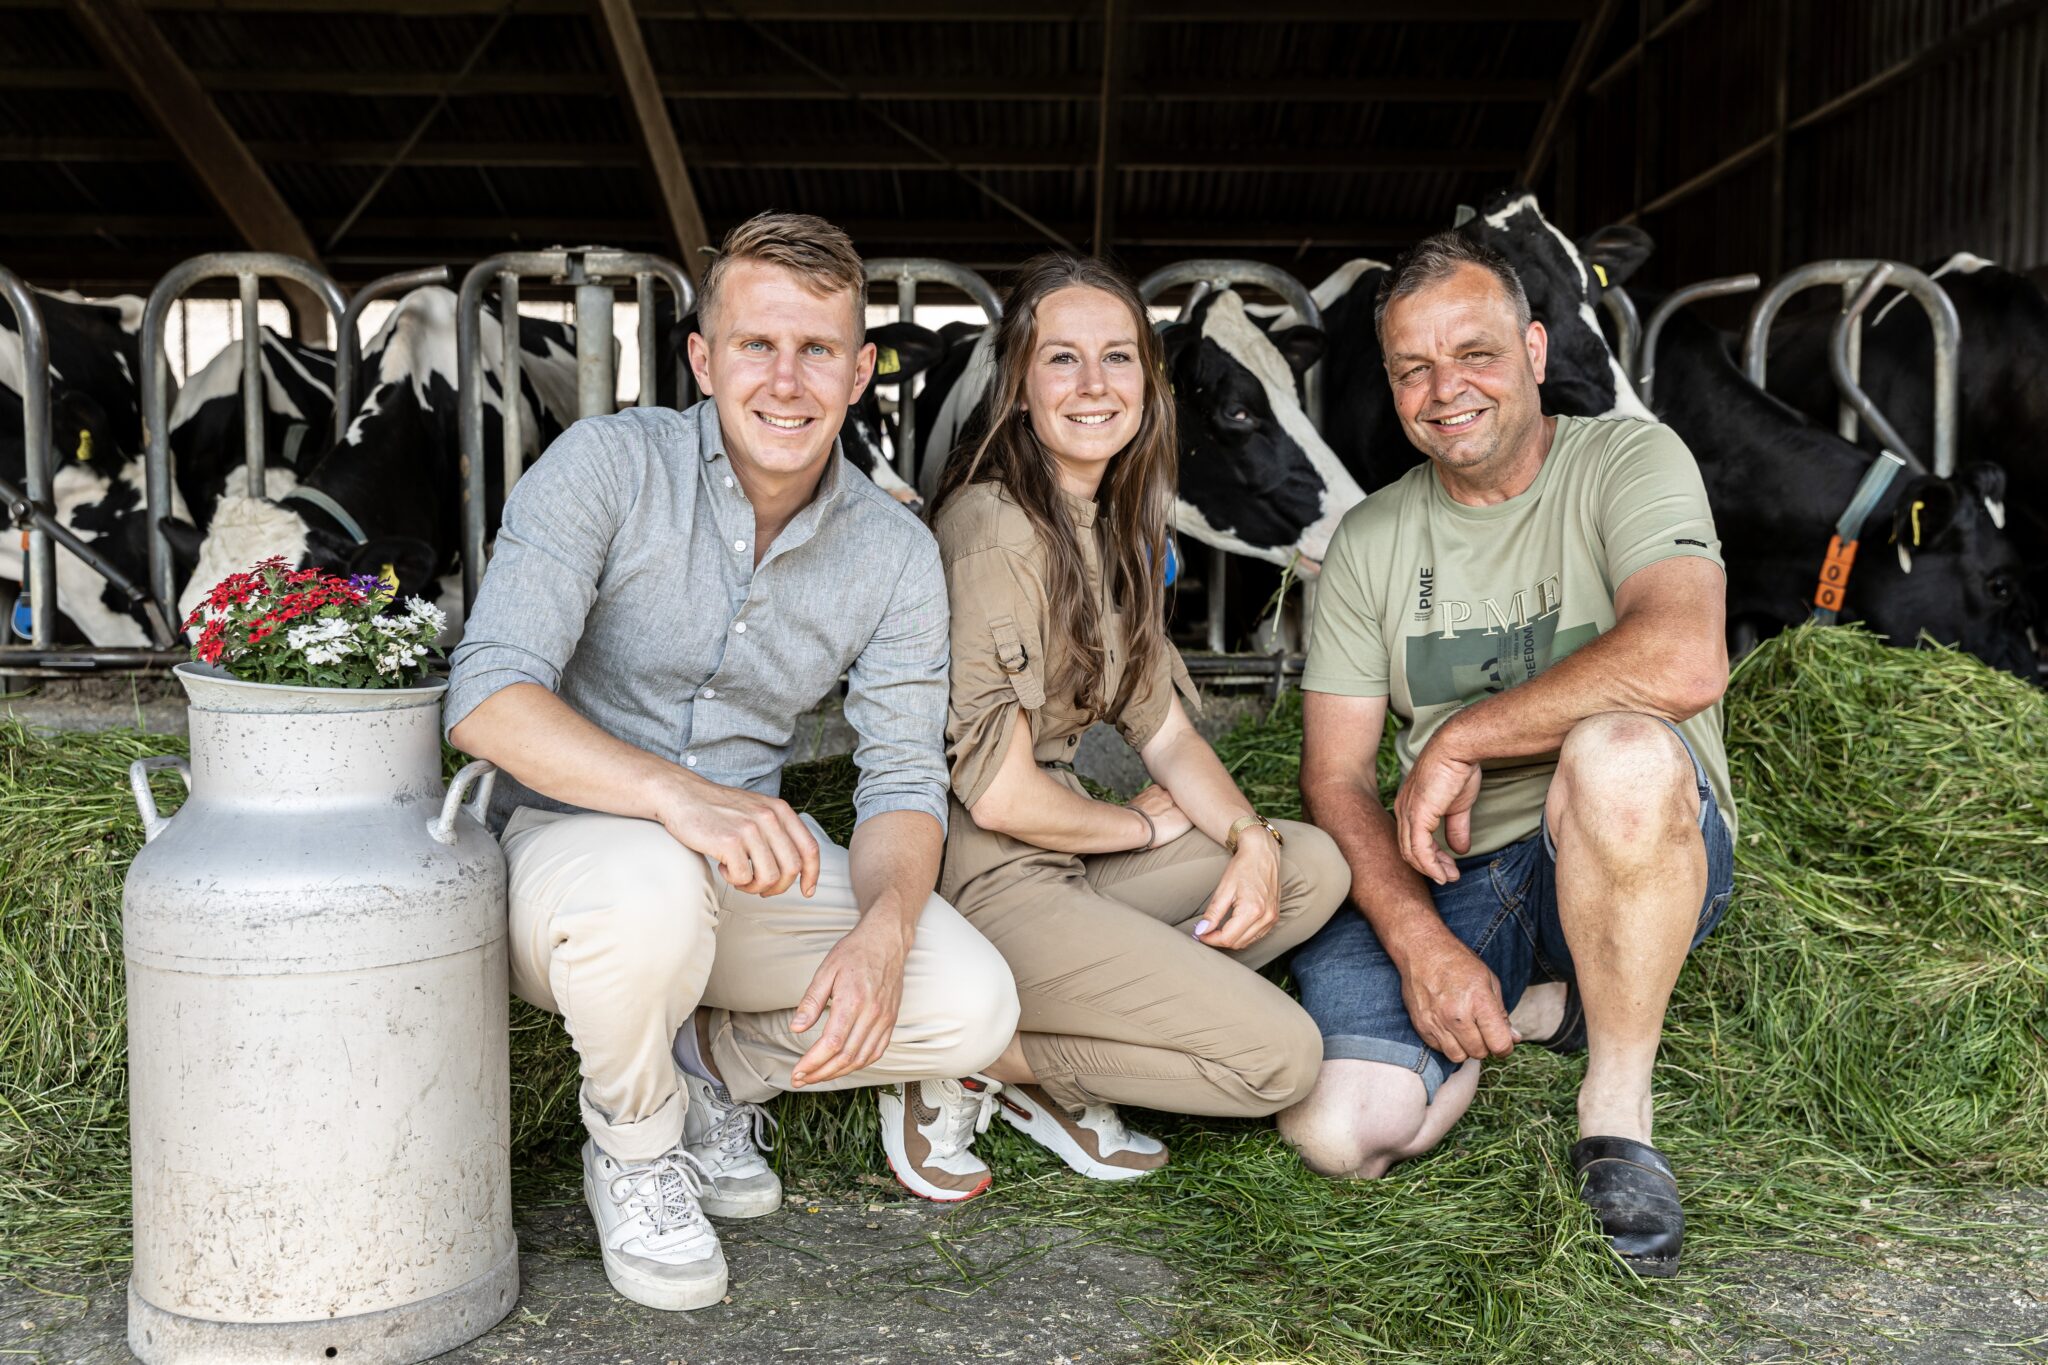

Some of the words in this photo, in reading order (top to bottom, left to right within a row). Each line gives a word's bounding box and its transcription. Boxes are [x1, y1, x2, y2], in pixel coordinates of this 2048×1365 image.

[1419, 567, 1434, 609] PME
[1437, 571, 1561, 640] PME
[1523, 626, 1536, 679] REEDOM
